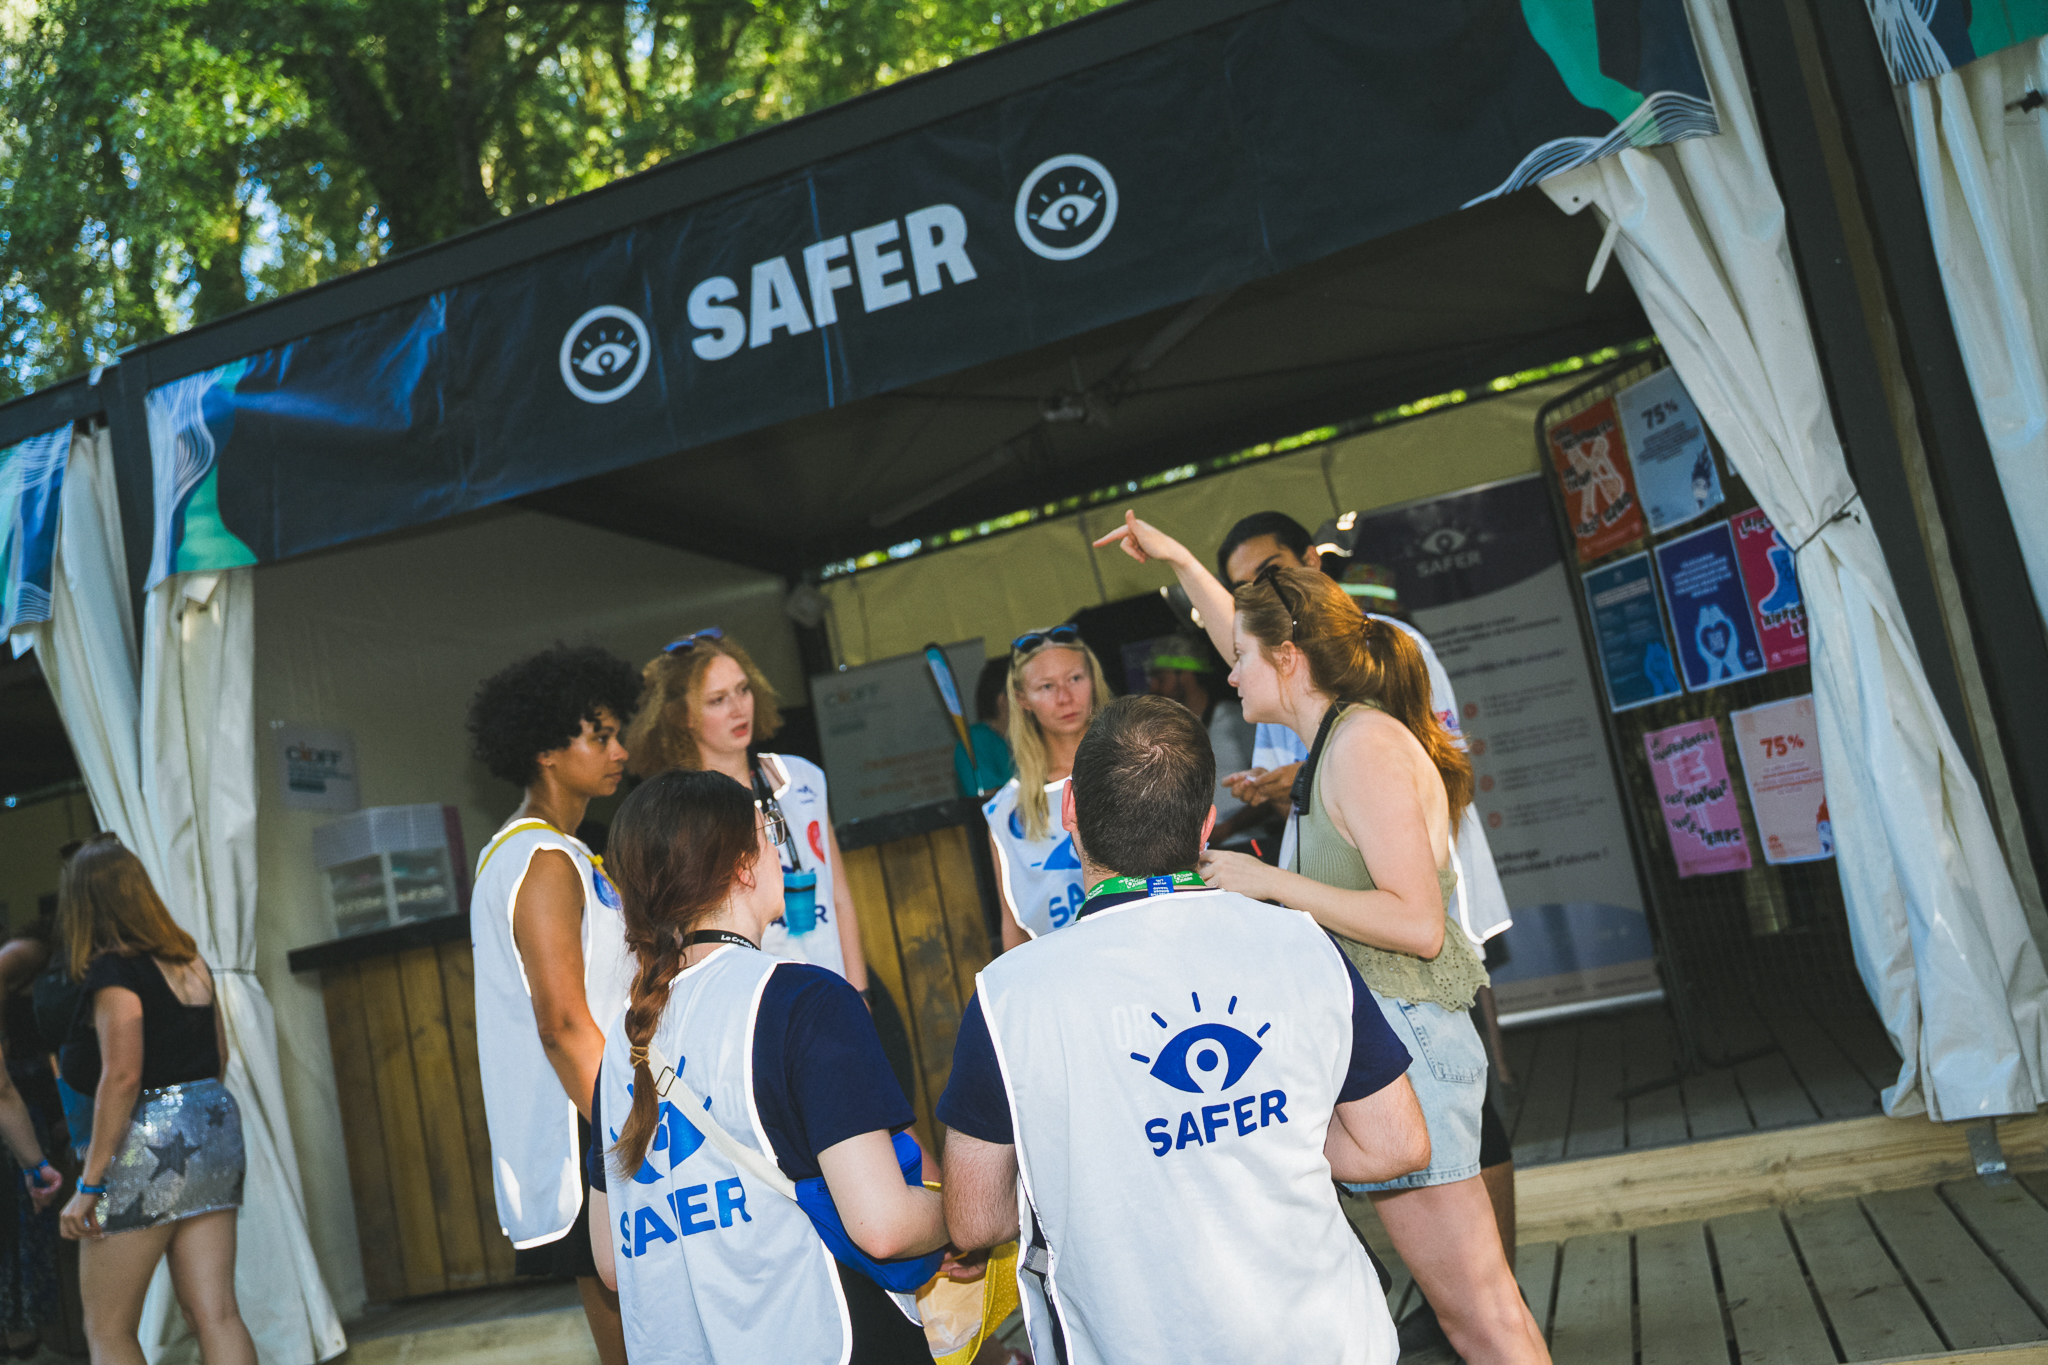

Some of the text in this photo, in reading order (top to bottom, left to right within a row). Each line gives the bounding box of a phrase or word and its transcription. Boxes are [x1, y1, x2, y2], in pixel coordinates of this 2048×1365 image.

[687, 203, 978, 361] SAFER
[1641, 400, 1679, 429] 75%
[1416, 551, 1483, 578] SAFER
[1760, 734, 1804, 759] 75%
[1049, 882, 1086, 929] SA
[720, 933, 731, 942] Le
[1145, 1089, 1288, 1157] SAFER
[620, 1176, 752, 1258] SAER
